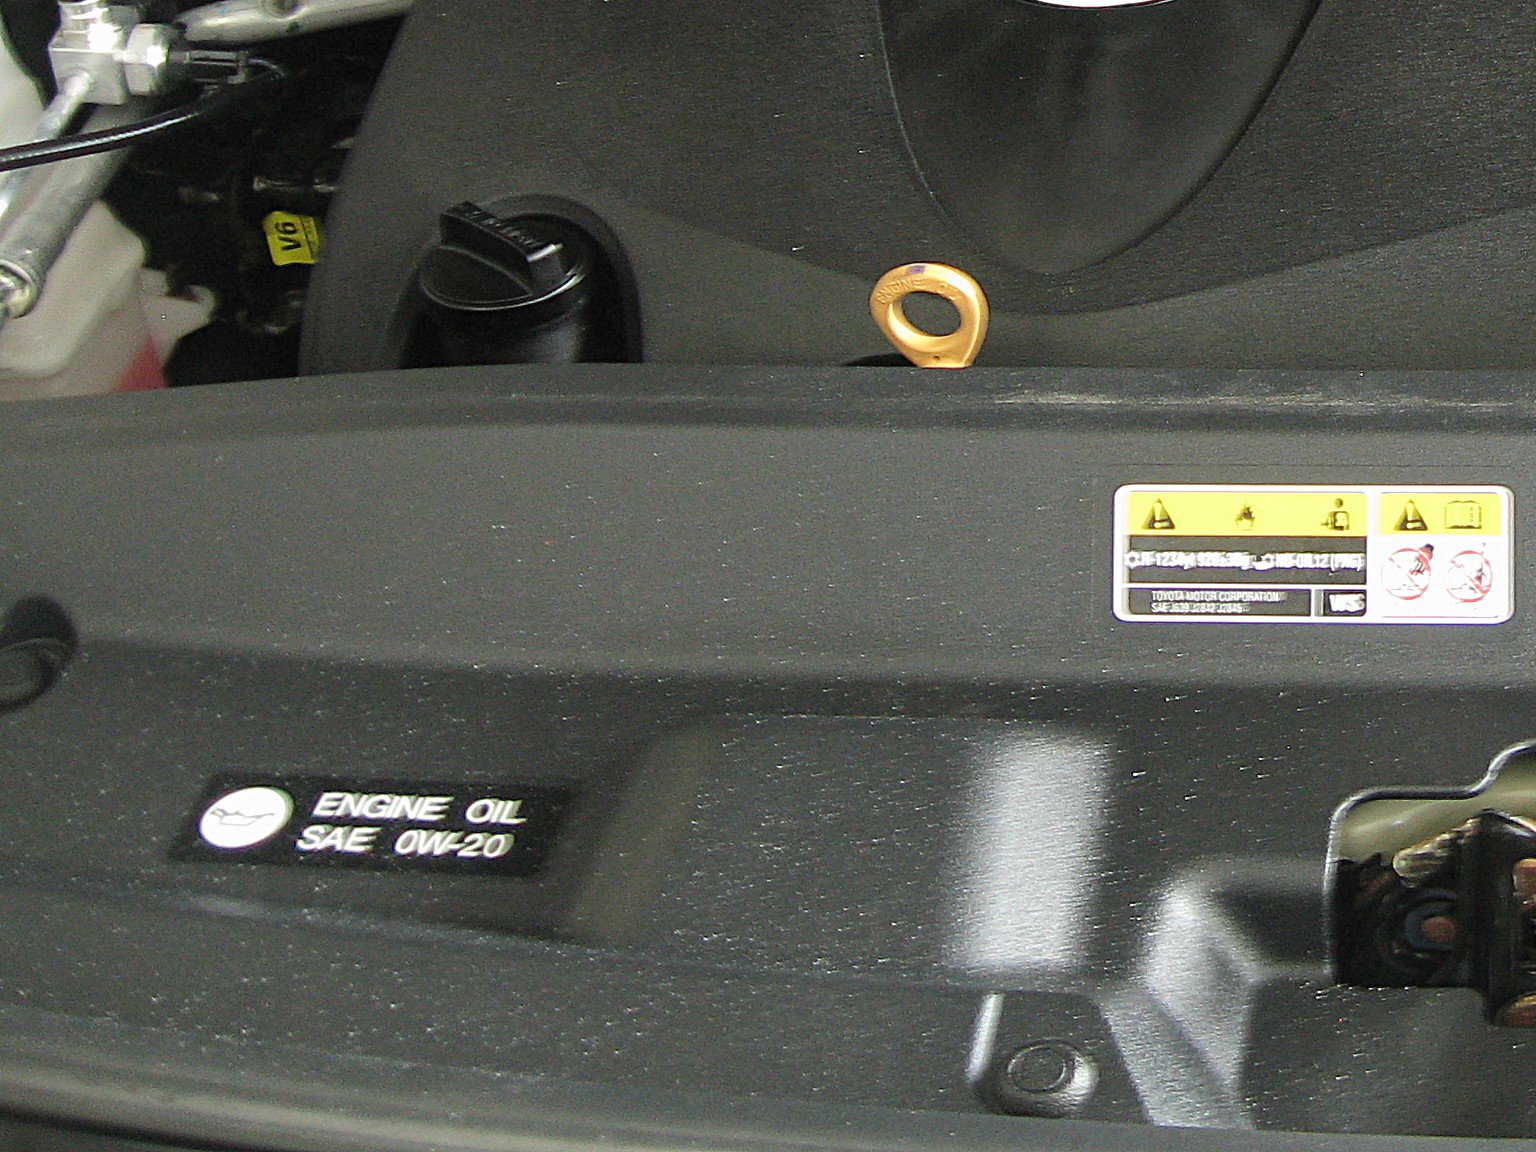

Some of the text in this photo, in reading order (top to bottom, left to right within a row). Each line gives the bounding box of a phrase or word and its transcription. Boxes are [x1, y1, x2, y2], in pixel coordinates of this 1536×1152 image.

[274, 221, 302, 251] V6
[1151, 590, 1283, 603] TOYOTA MOTOR CORPORATION
[312, 791, 527, 825] ENGINE OIL
[297, 823, 516, 859] SAE 0W-20
